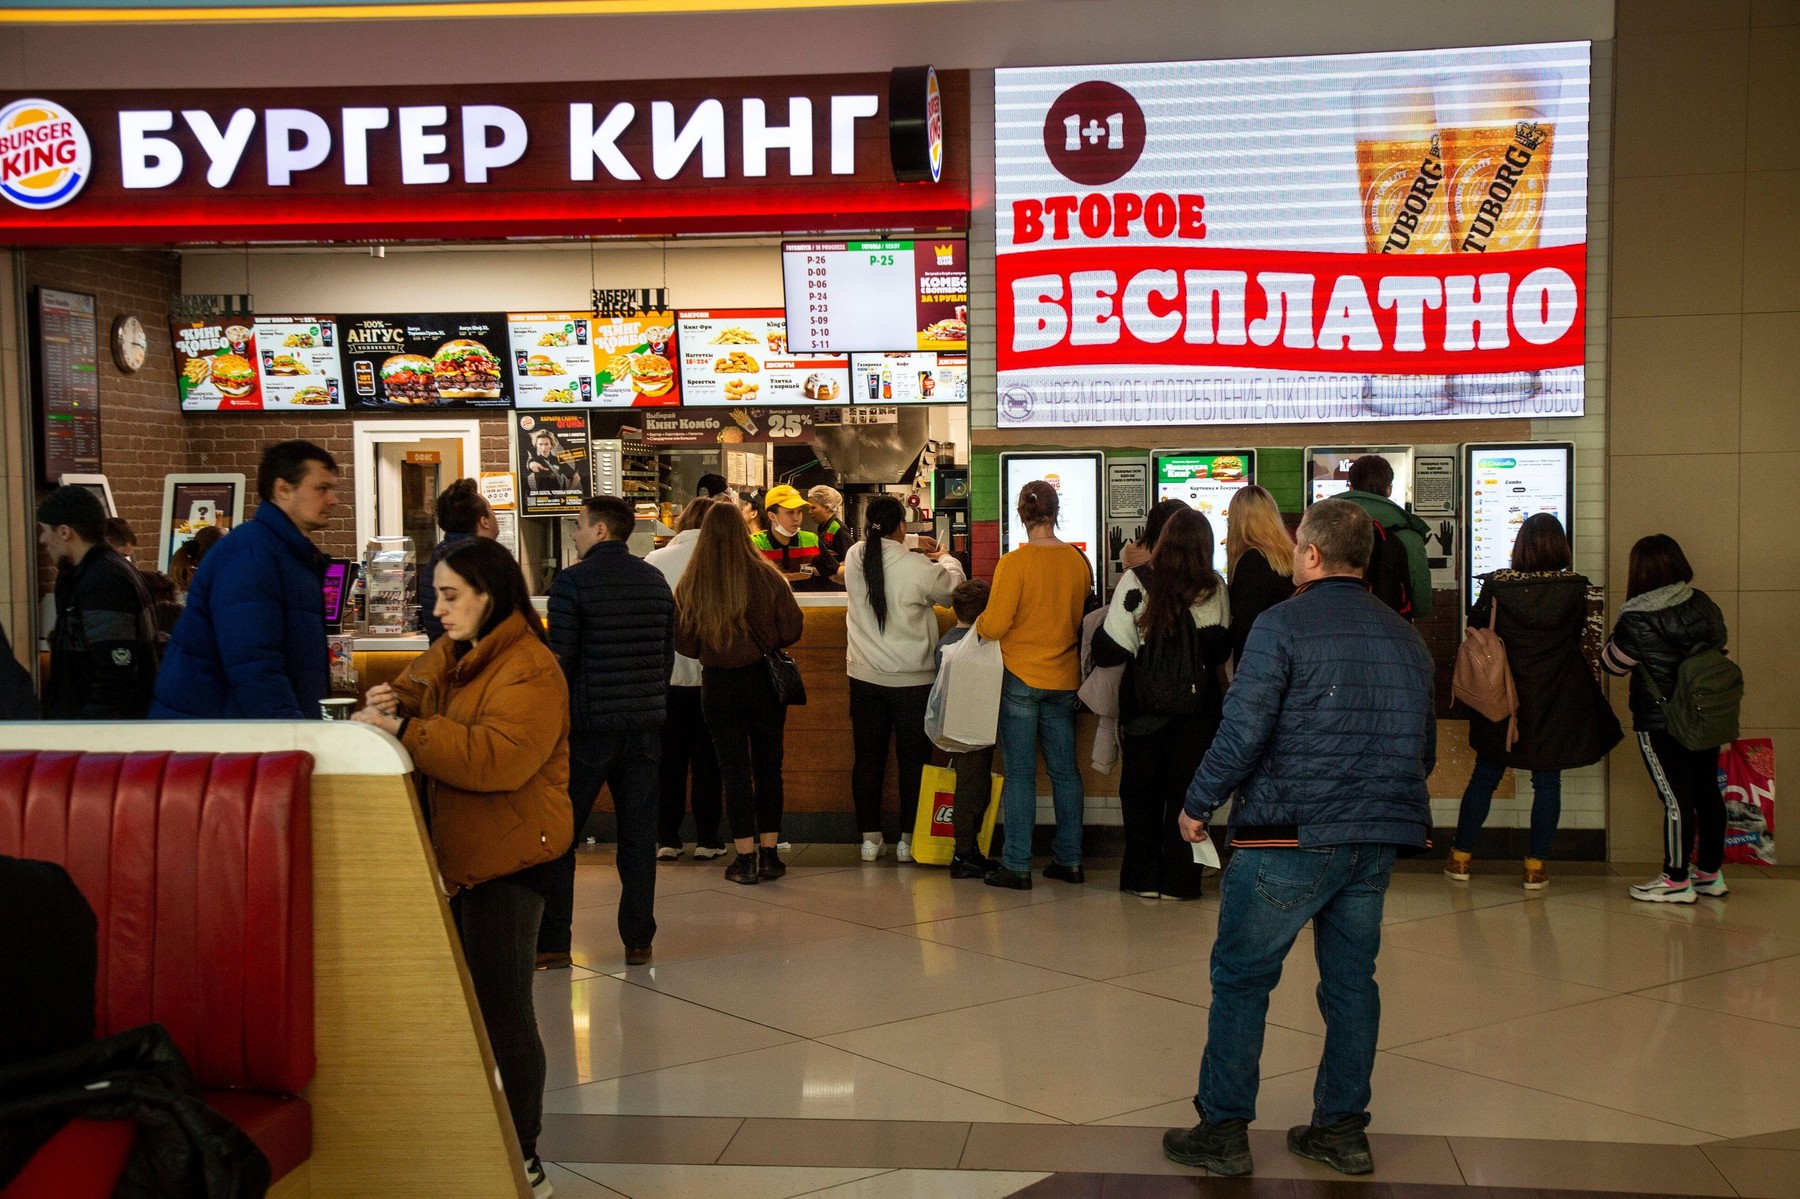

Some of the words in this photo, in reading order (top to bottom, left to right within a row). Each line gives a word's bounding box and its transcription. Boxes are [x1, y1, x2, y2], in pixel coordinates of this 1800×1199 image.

[1063, 112, 1124, 151] 1+1
[0, 121, 73, 155] BURGER
[118, 104, 527, 190] БУРГЕР
[569, 94, 880, 182] КИНГ
[2, 139, 77, 182] KING
[1461, 145, 1534, 254] TUBORG
[1012, 192, 1207, 244] ВТОРОЕ
[807, 256, 826, 264] P-26
[869, 255, 895, 266] P-25
[808, 268, 827, 276] D-00
[808, 280, 827, 289] D-06
[592, 289, 637, 302] ЗАБЕРИ
[809, 292, 828, 301] P-24
[592, 302, 637, 318] ЗДЕСЬ
[810, 304, 828, 313] P-23
[1011, 267, 1578, 352] БЕСПЛАТНО
[363, 320, 385, 328] 100%
[810, 316, 828, 325] S-09
[347, 328, 405, 343] АНГУС
[811, 328, 830, 337] D-10
[175, 337, 230, 358] КОМБО
[811, 340, 829, 348] S-11
[646, 419, 678, 430] Кинг
[679, 418, 721, 430] Комбо
[768, 415, 813, 438] 25%
[415, 453, 433, 462] ОФИС
